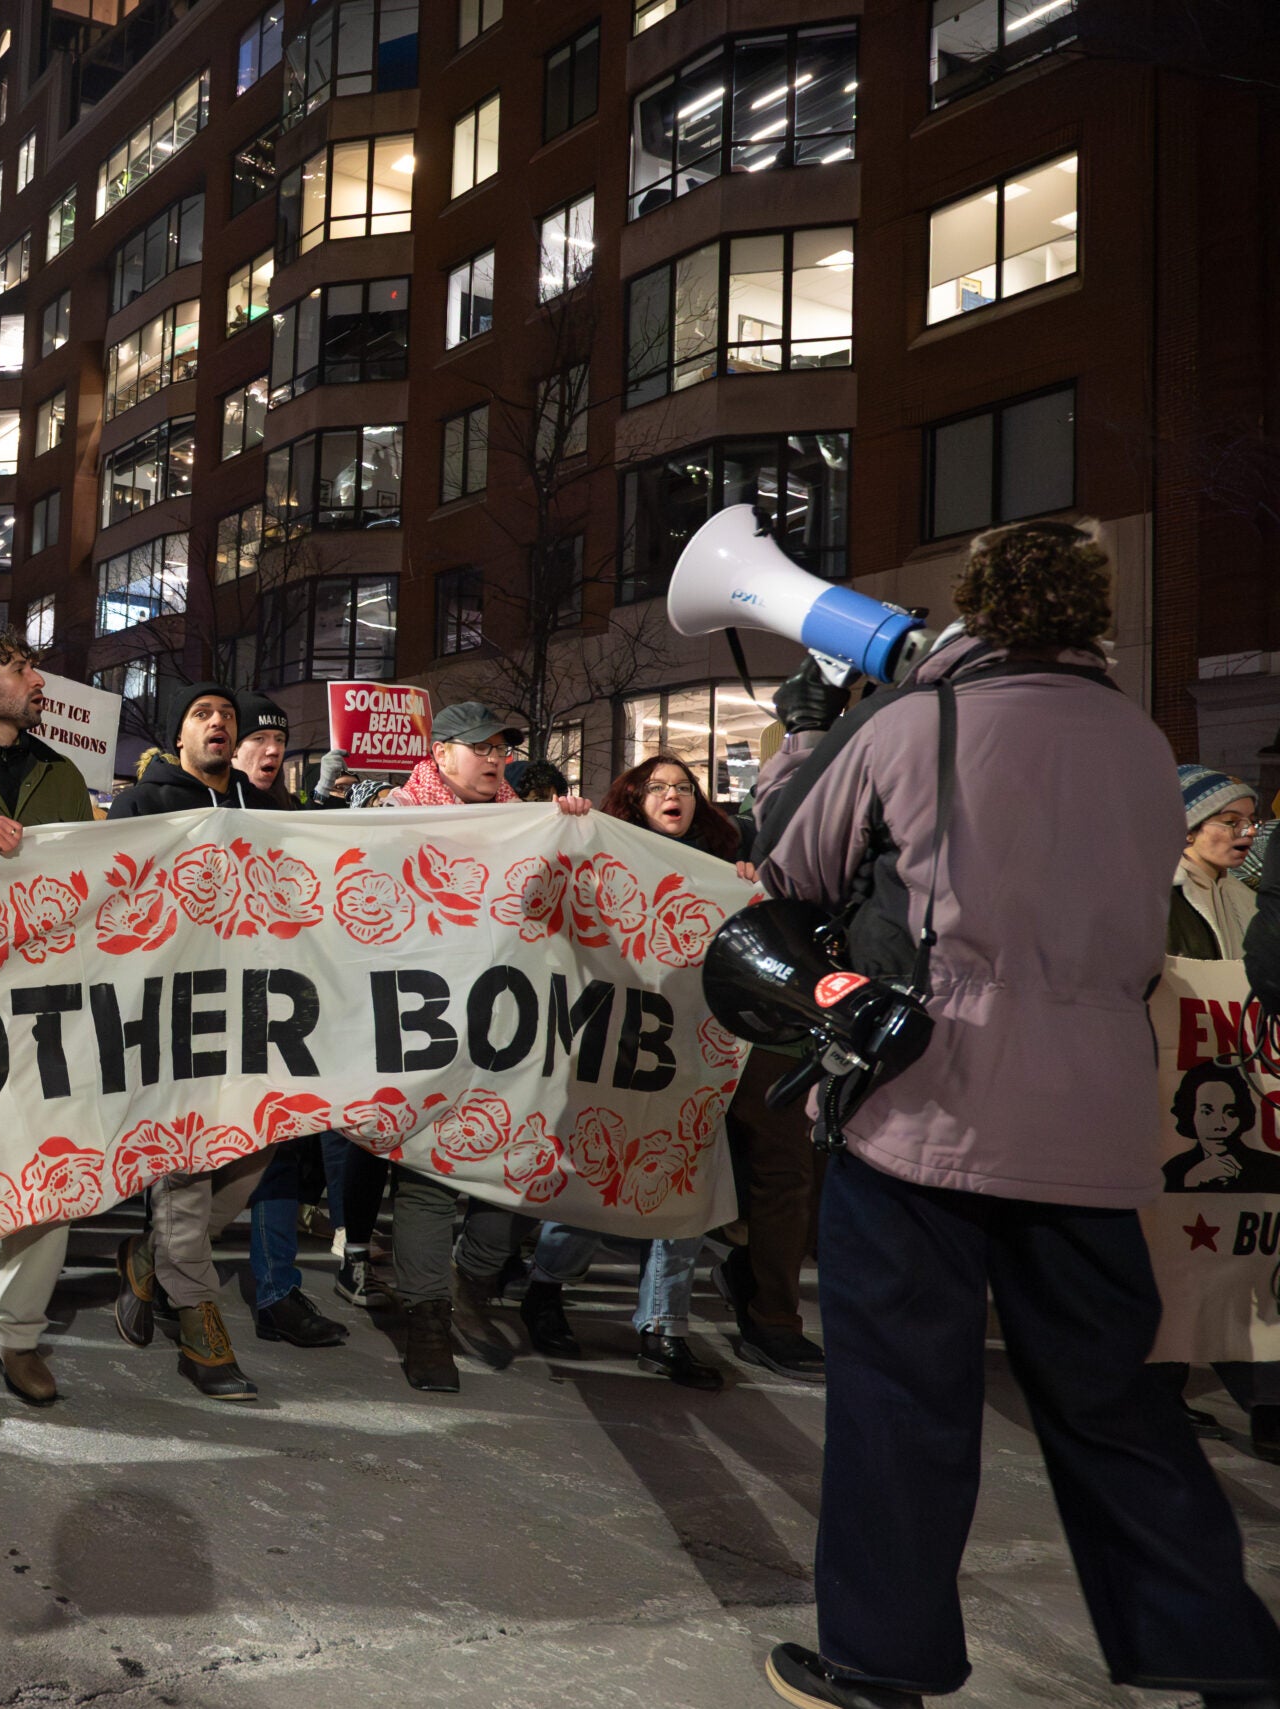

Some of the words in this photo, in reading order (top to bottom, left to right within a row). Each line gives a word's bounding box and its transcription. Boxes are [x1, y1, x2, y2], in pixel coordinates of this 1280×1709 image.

[40, 697, 66, 716] ELT
[68, 705, 91, 724] ICE
[344, 690, 425, 716] SOCIALISM
[258, 714, 277, 726] MAX
[369, 713, 411, 733] BEATS
[49, 725, 107, 755] PRISONS
[351, 732, 427, 757] FASCISM!
[762, 957, 796, 981] PYLE
[370, 964, 677, 1093] BOMB
